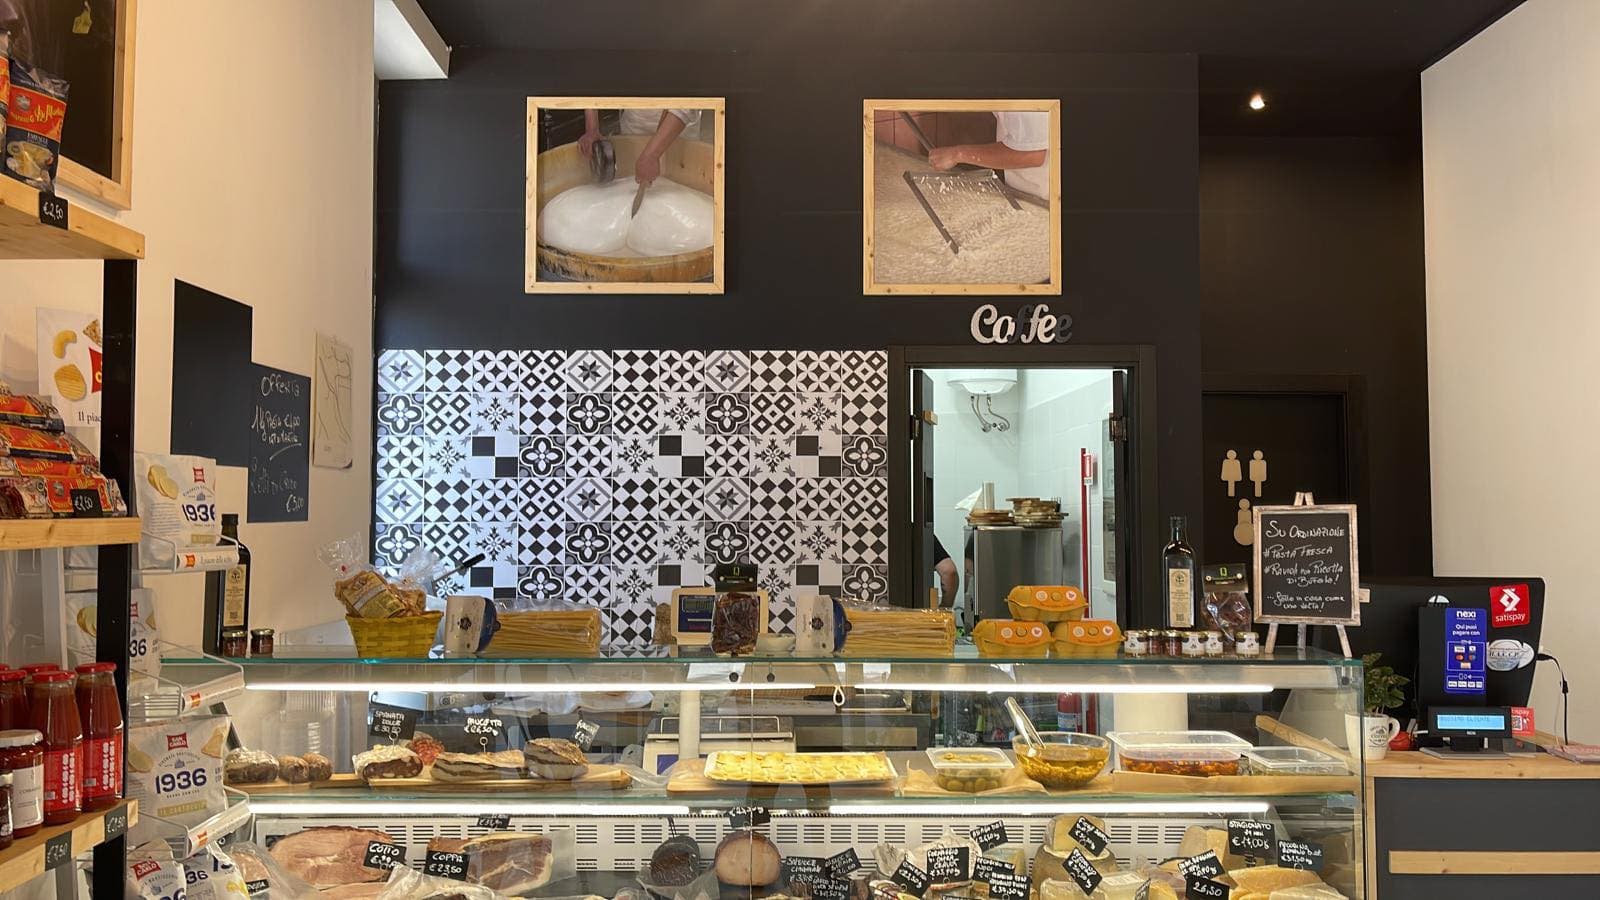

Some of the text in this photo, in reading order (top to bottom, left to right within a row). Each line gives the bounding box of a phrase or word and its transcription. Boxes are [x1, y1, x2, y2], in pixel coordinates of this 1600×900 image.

[970, 303, 1073, 344] Coffee
[1456, 610, 1477, 618] nexi
[1495, 612, 1526, 622] satispay
[129, 638, 147, 658] 36
[155, 767, 207, 794] 1936
[369, 843, 400, 856] COTTO
[432, 852, 464, 863] COPPA
[185, 869, 209, 884] 36
[1193, 881, 1223, 898] 26,50
